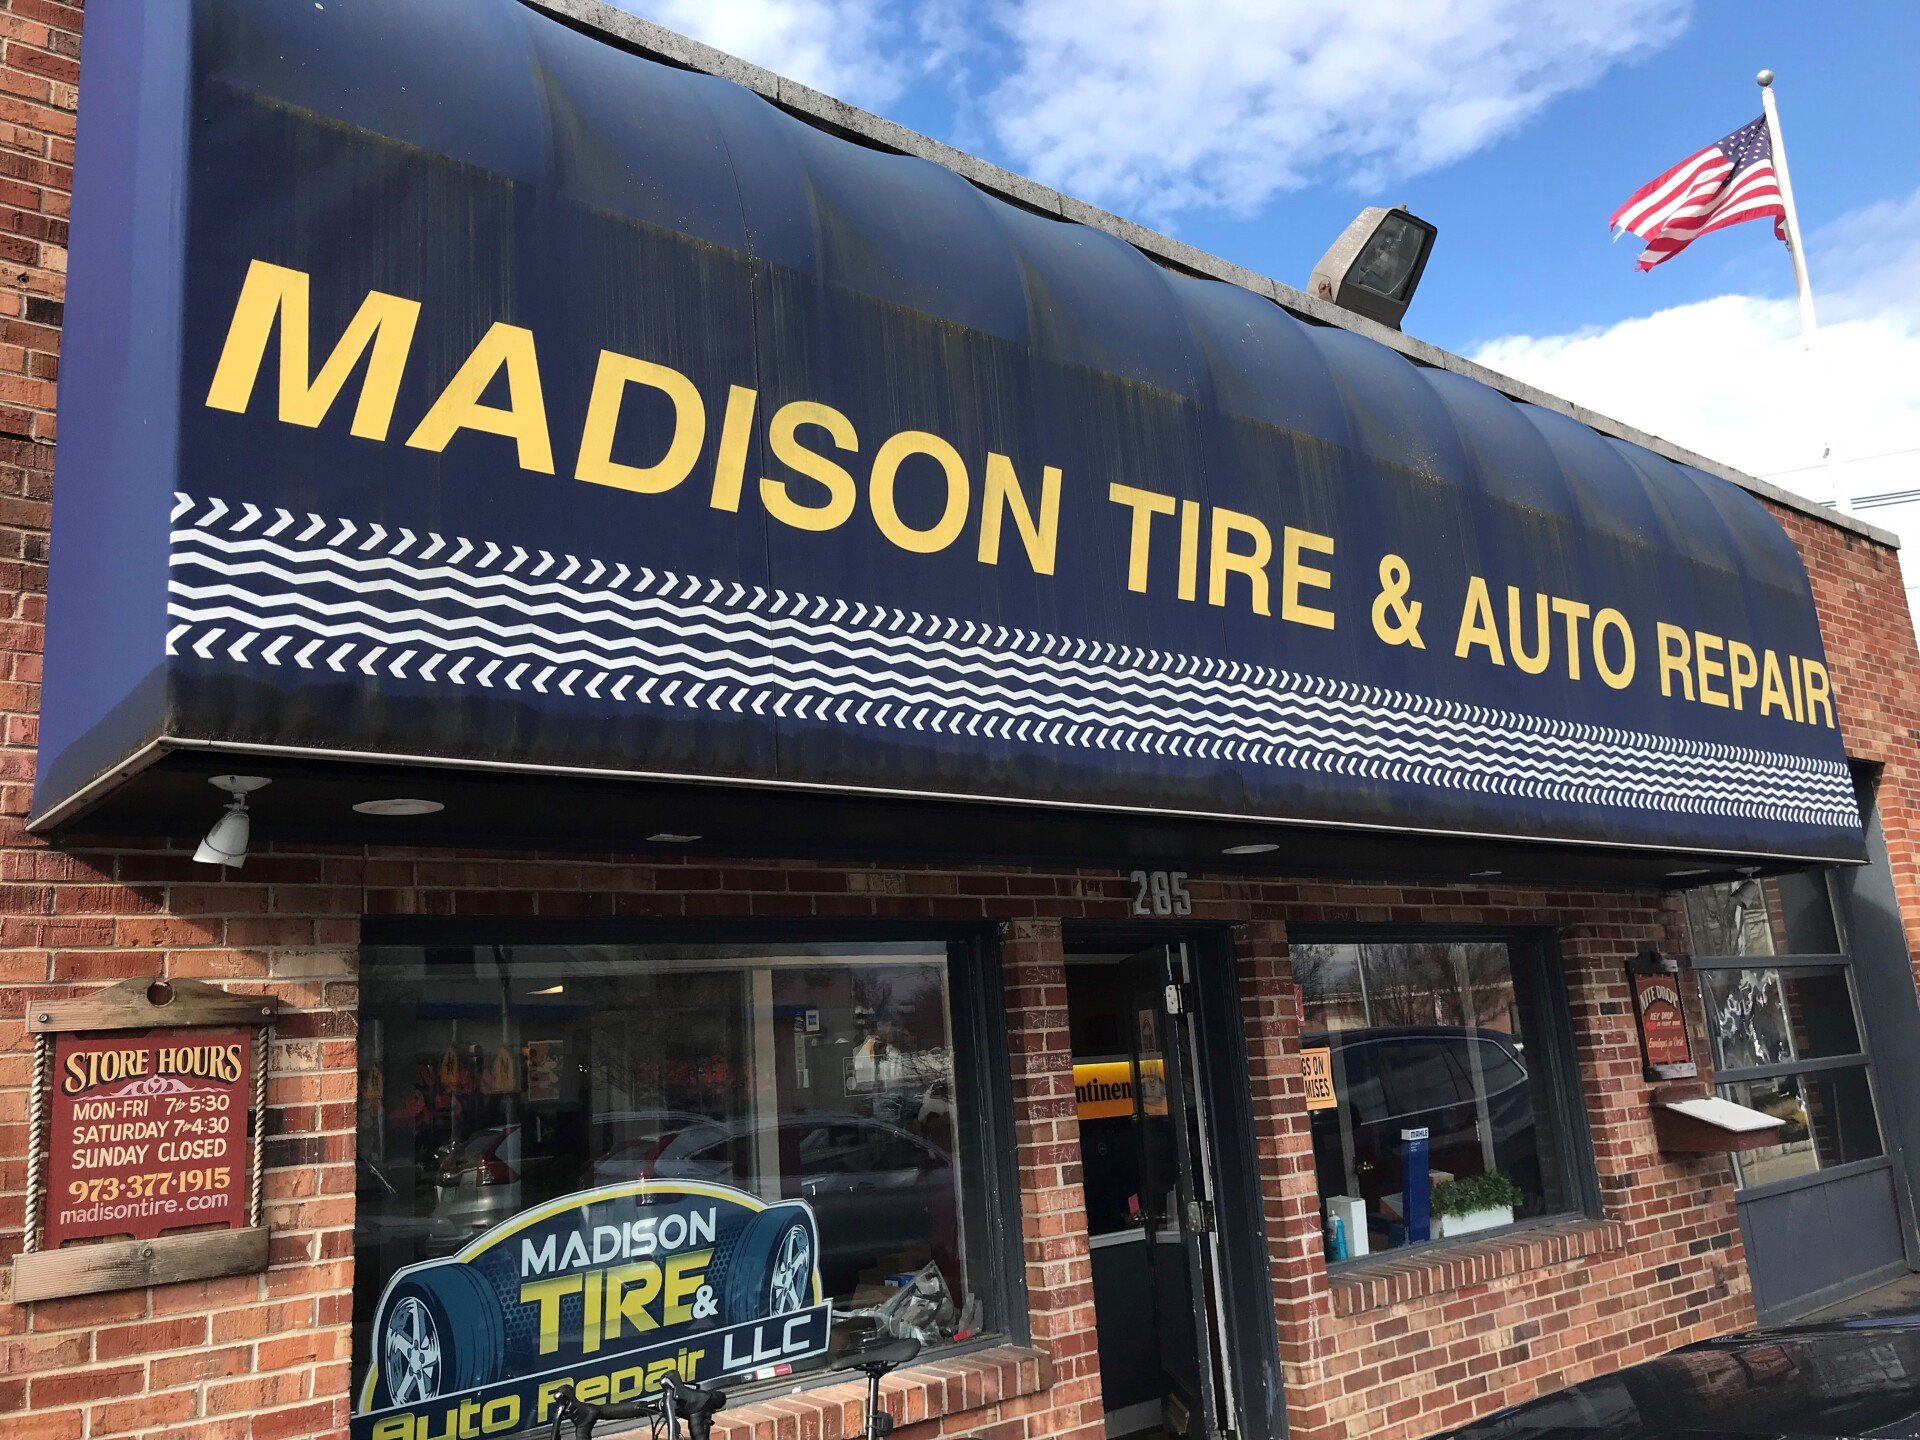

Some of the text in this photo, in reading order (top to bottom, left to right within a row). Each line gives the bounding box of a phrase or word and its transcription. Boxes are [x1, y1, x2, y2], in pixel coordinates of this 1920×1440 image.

[205, 259, 1836, 729] MADISON TIRE & AUTO REPAIR
[1130, 870, 1192, 916] 285
[64, 1044, 242, 1094] STORE HOURS
[1313, 1056, 1324, 1075] ON
[72, 1120, 170, 1145] SATURDAY
[191, 1116, 230, 1136] 4:30
[73, 1099, 149, 1121] MON-FRI
[189, 1094, 230, 1113] 5:30
[71, 1137, 228, 1170] SUNDAY CLOSED
[60, 1192, 229, 1225] madisontire.com
[521, 1206, 717, 1277] MADISON
[520, 1247, 719, 1356] TIRE &
[372, 1394, 521, 1440] Auto
[722, 1314, 812, 1371] LLC
